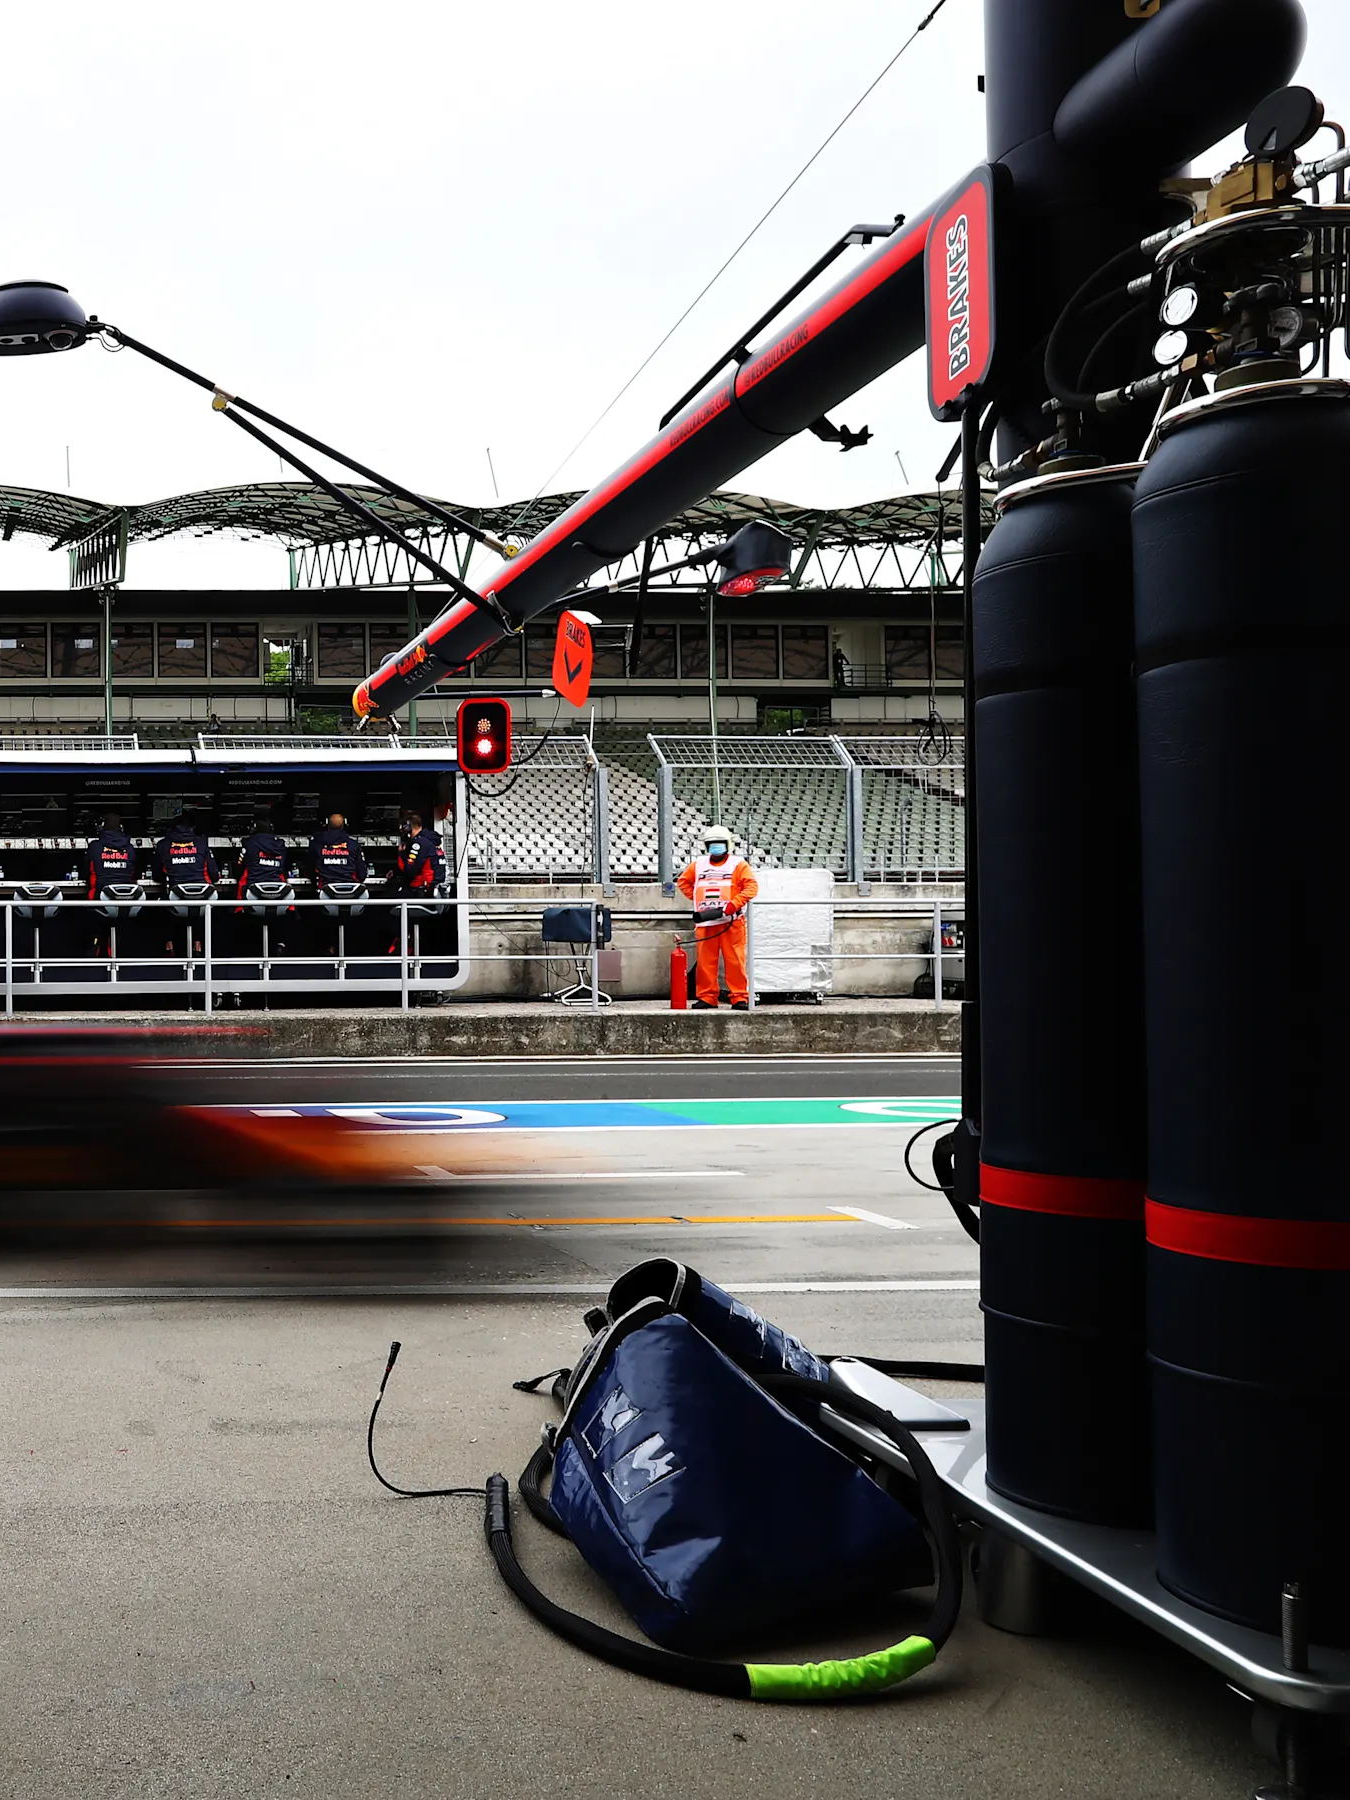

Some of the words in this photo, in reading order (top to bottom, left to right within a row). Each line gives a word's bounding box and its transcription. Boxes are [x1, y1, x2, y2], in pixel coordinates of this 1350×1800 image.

[946, 213, 970, 382] BRAKES
[743, 323, 809, 388] @REDBULLRACING
[565, 618, 586, 649] BRAKES
[103, 861, 120, 869] Mobil
